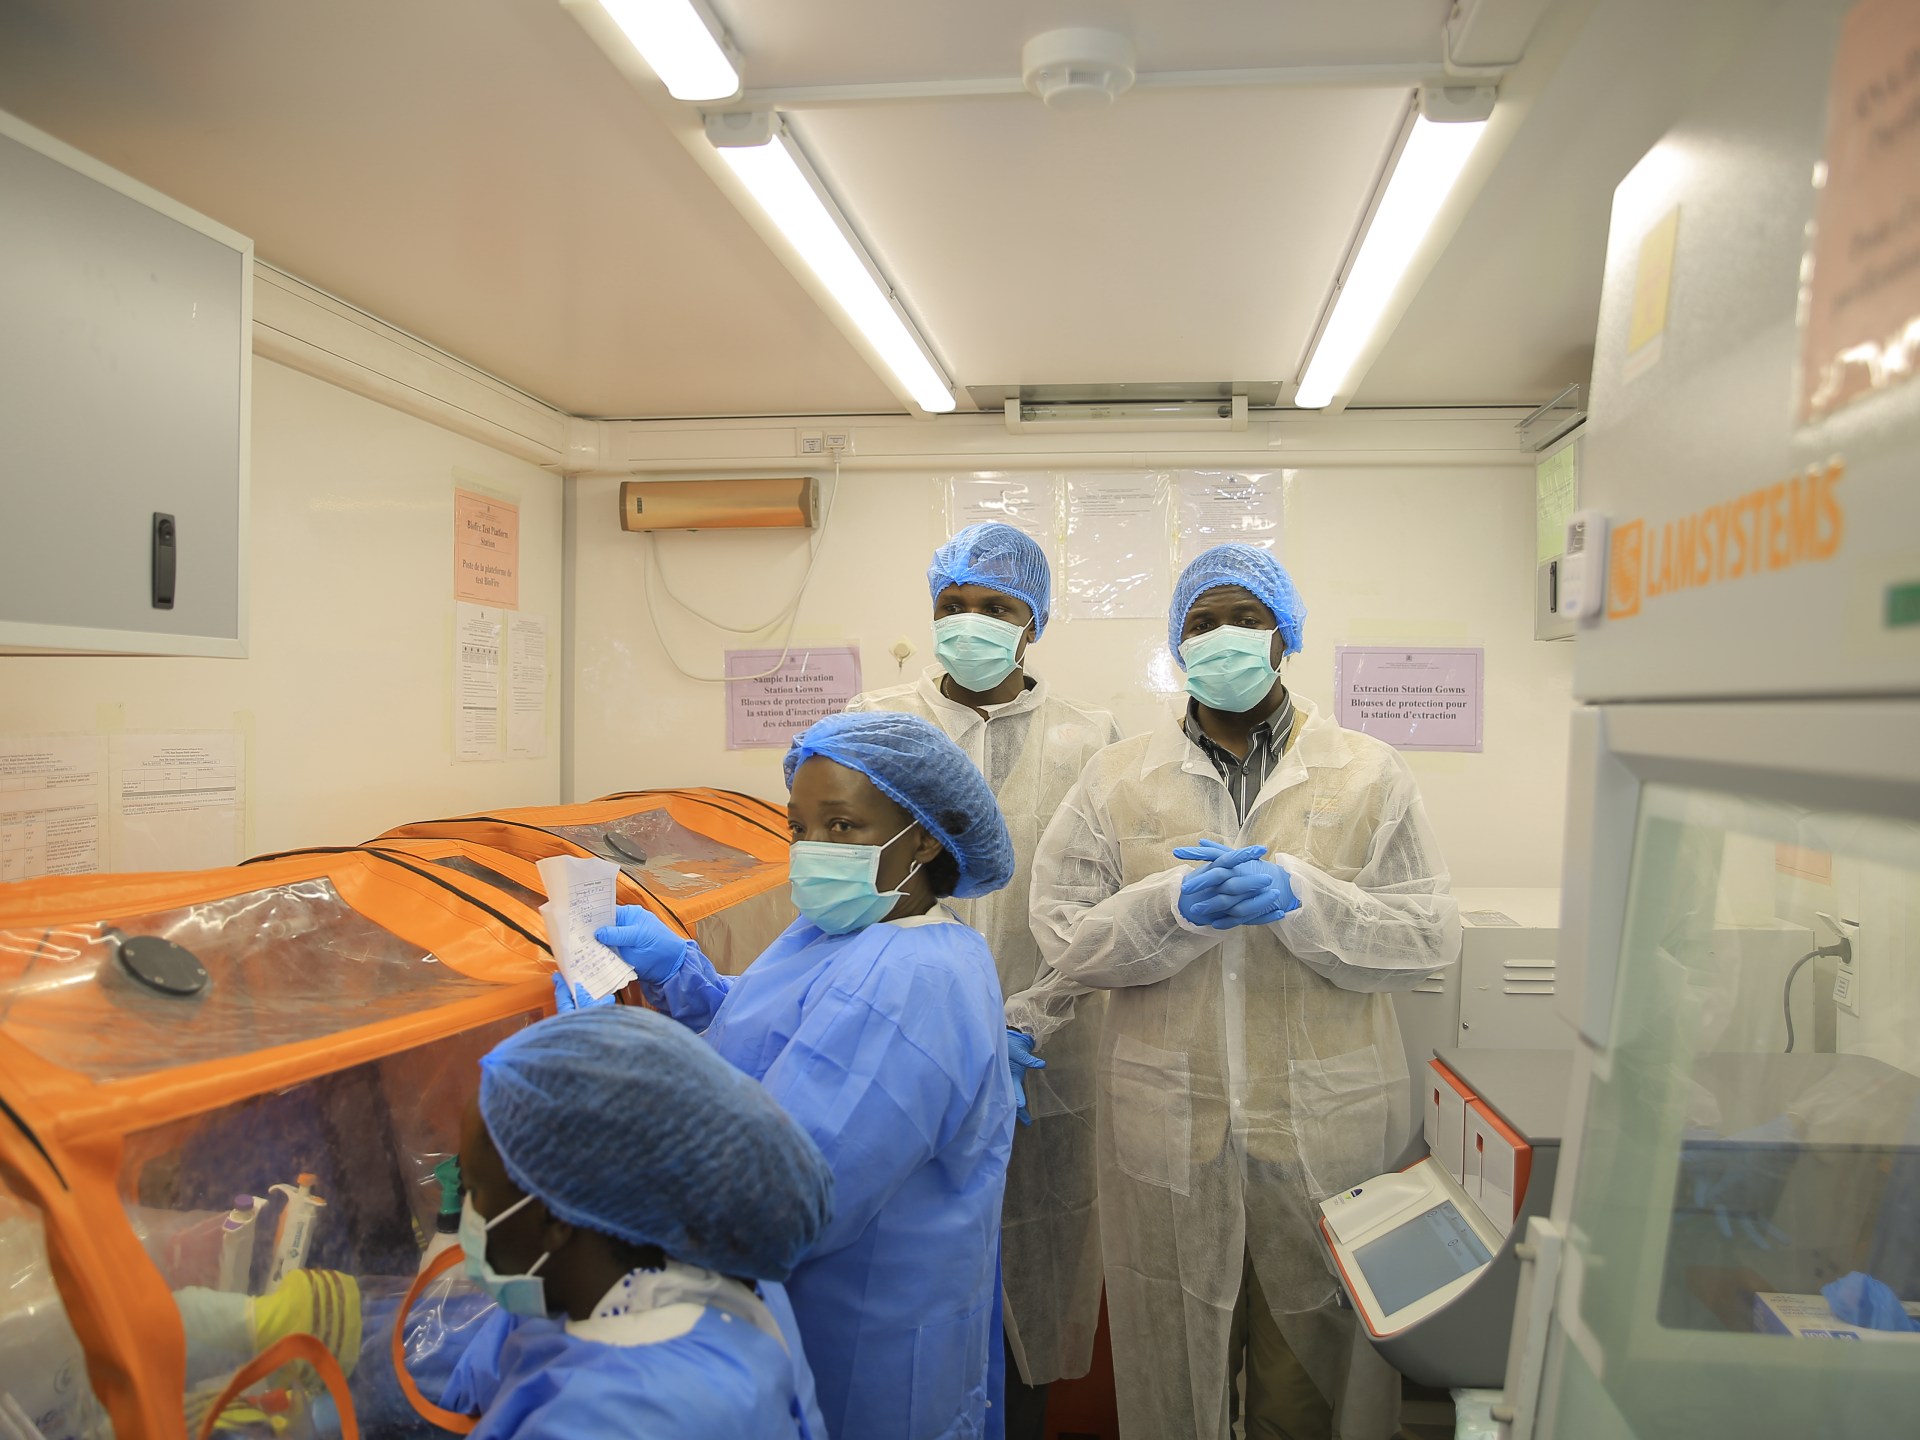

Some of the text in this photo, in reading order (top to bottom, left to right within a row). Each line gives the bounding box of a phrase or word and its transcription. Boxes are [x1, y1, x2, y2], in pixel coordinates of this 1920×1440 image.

[482, 524, 491, 534] Test
[491, 526, 508, 538] Platform
[1646, 465, 1845, 597] LAMSYSTEMS
[463, 560, 473, 570] Poste
[474, 562, 479, 570] de
[480, 563, 484, 571] la
[485, 564, 506, 576] plateforme
[753, 675, 834, 685] Sample Inactivation
[1353, 684, 1466, 694] Extraction Station Gowns
[785, 698, 826, 706] protection
[1351, 699, 1467, 709] Blouses de protection pour
[747, 709, 754, 717] la
[1371, 711, 1401, 719] station
[1403, 711, 1457, 719] d'extraction
[762, 720, 776, 728] des
